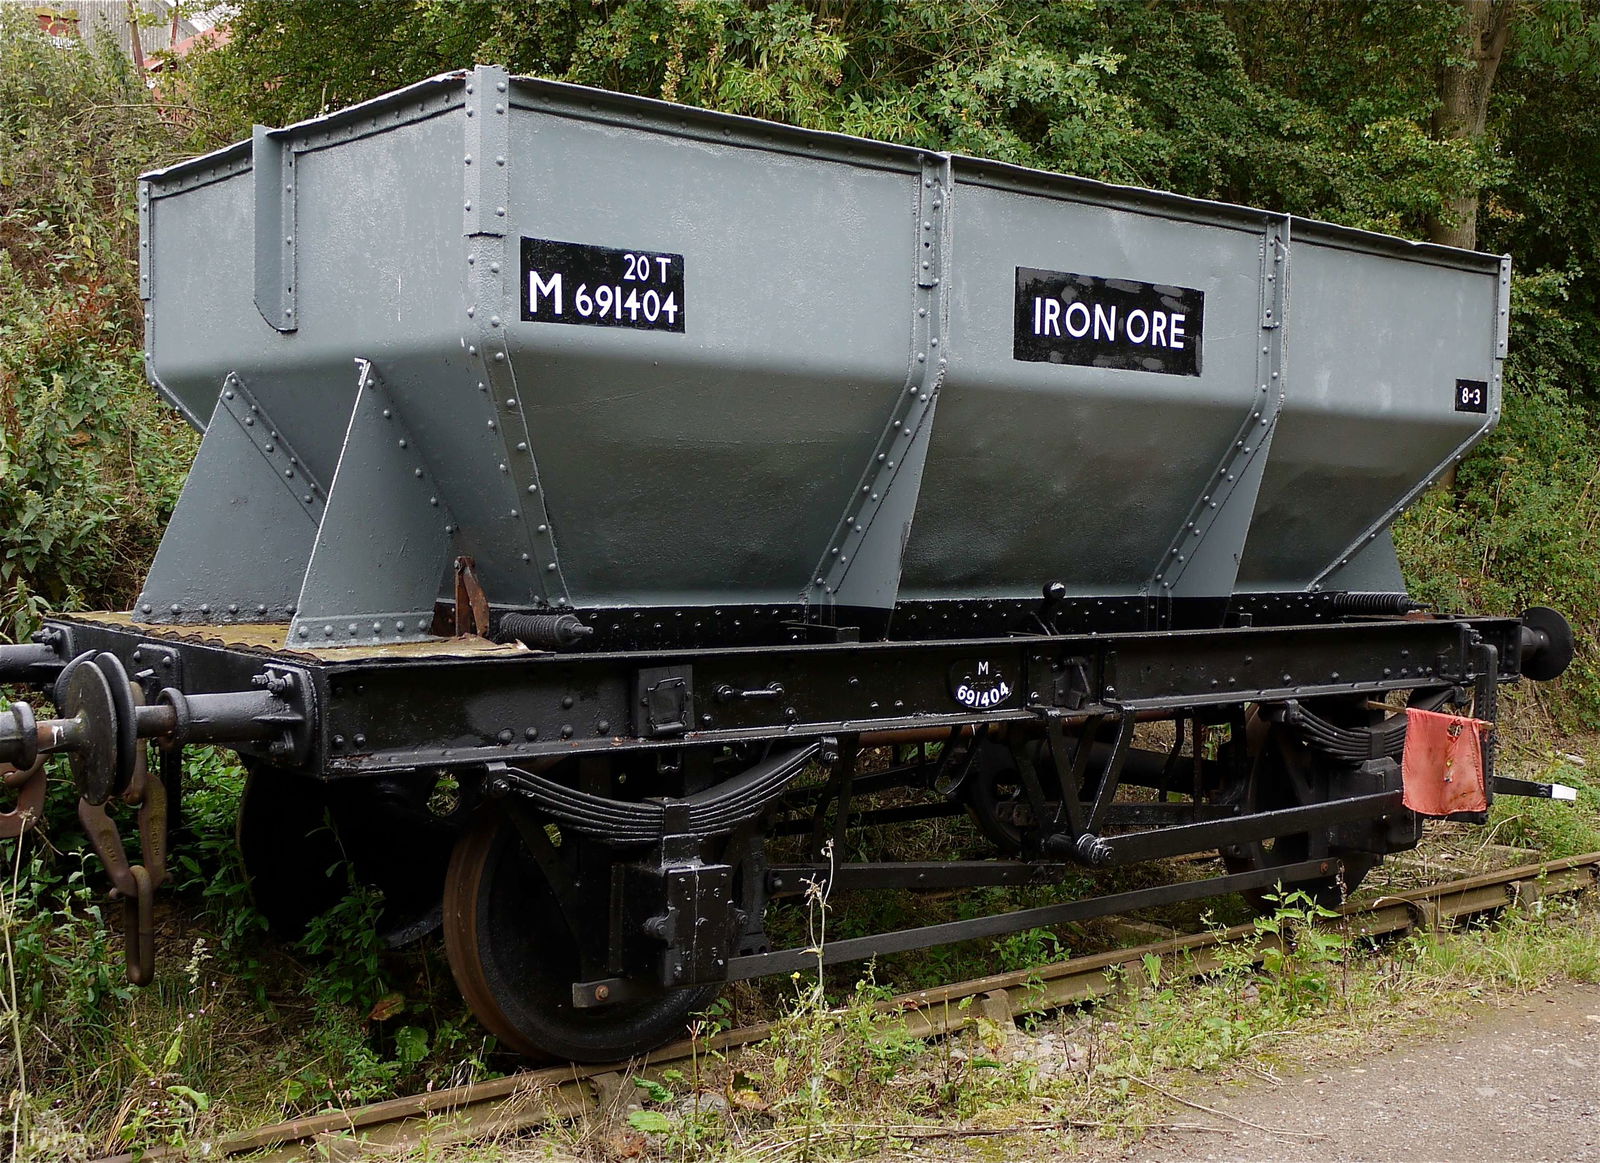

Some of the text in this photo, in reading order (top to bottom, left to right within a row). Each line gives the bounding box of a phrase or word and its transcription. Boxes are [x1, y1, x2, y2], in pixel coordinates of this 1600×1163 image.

[623, 253, 672, 283] 20 T
[529, 270, 678, 324] M 691404
[1034, 296, 1186, 349] IRON ORE
[977, 661, 989, 676] M
[957, 681, 1010, 707] 691404
